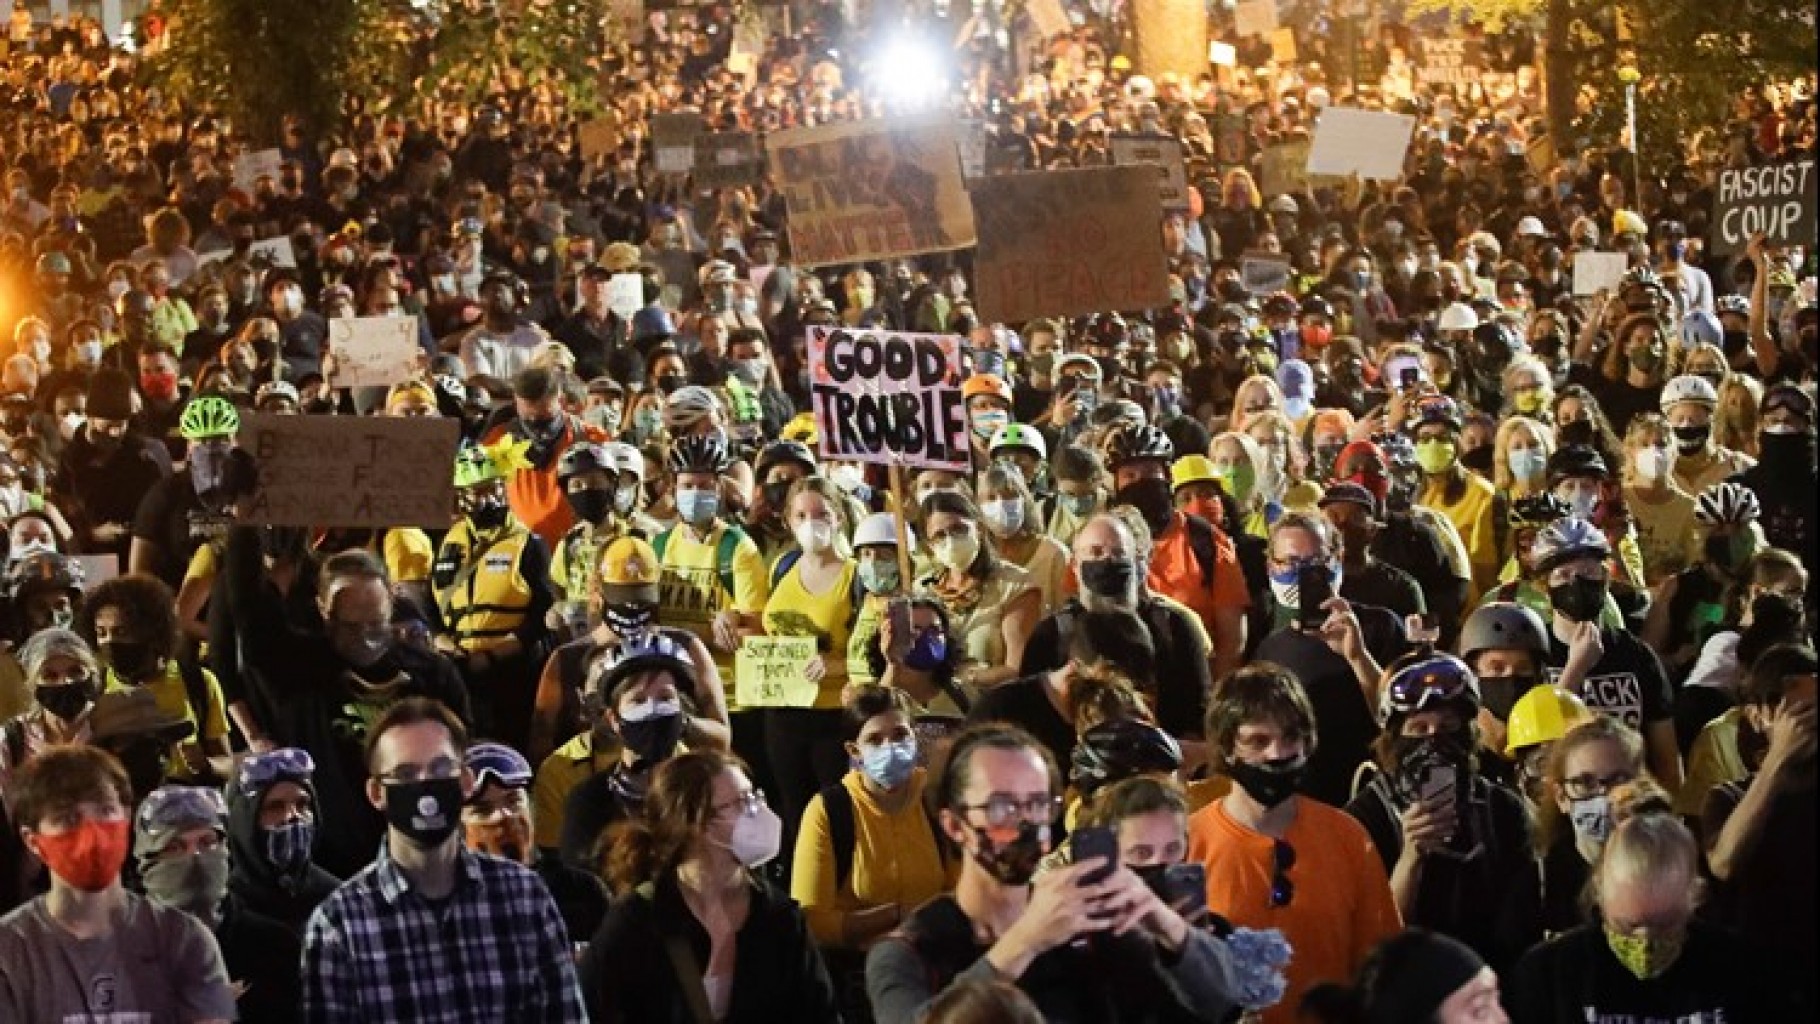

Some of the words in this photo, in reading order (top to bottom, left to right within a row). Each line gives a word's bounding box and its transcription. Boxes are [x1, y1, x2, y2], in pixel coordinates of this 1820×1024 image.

[1720, 160, 1814, 203] FASCIST
[1722, 201, 1802, 244] COUP
[1000, 258, 1156, 317] PEACE
[813, 383, 969, 461] TROUBLE
